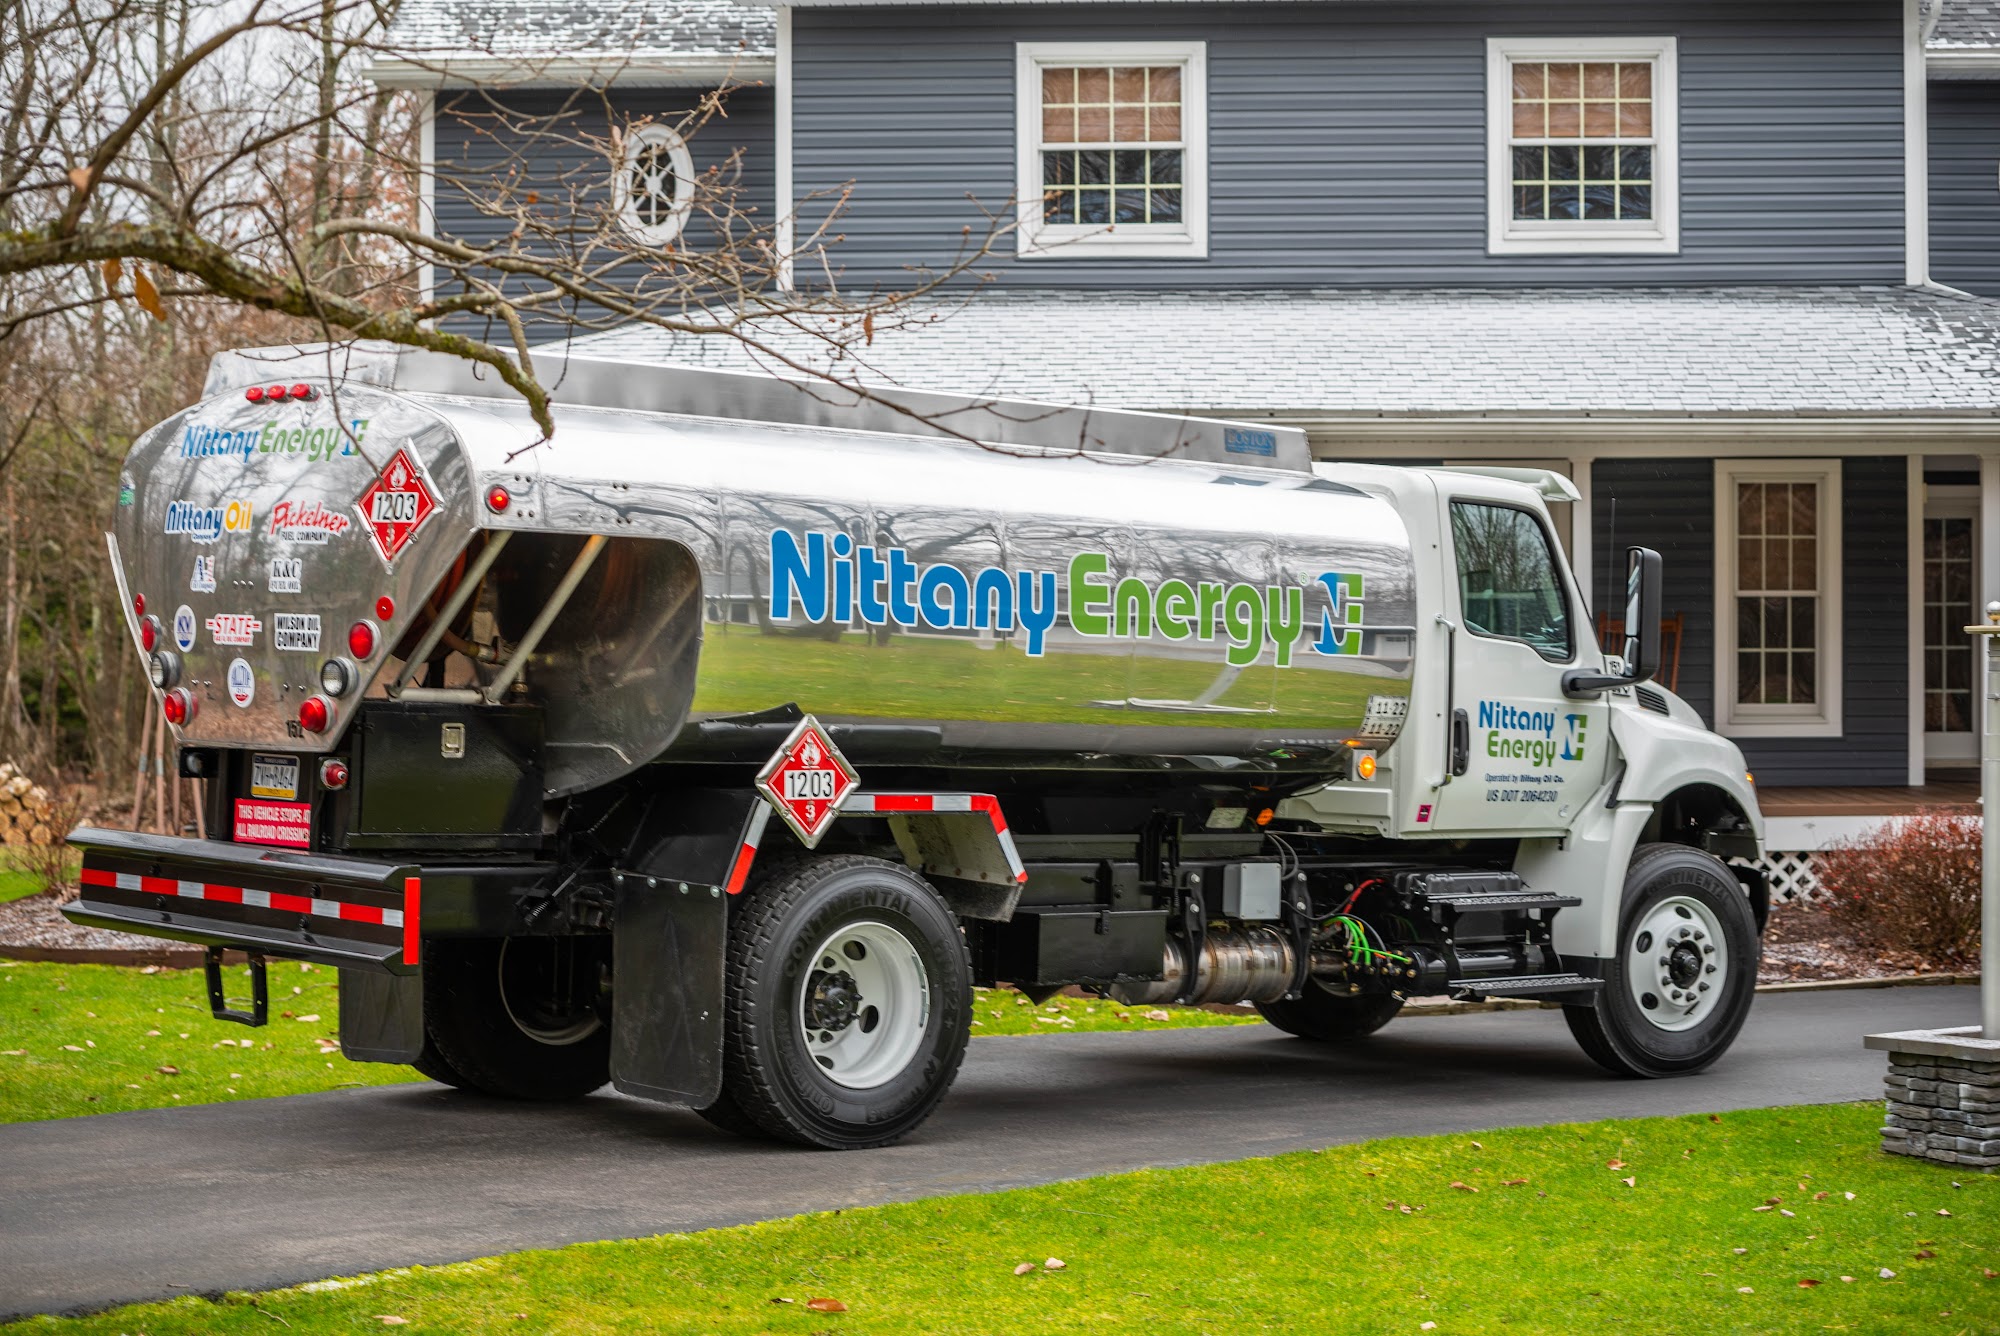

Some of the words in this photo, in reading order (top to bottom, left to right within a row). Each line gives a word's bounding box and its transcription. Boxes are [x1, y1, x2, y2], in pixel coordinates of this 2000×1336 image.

[180, 424, 260, 464] Nittany
[259, 420, 342, 463] Energy
[225, 501, 253, 531] Oil
[377, 493, 416, 521] 1203
[269, 500, 349, 535] Pickelner
[769, 528, 1057, 657] Nittany
[1068, 552, 1303, 668] Energy
[214, 616, 252, 635] STATE
[277, 616, 304, 630] WILSON
[307, 617, 319, 631] OIL
[277, 631, 318, 649] COMPANY
[1375, 702, 1407, 716] 11-22
[1368, 722, 1401, 736] 11-22
[1479, 700, 1555, 739] Nittany
[1487, 730, 1557, 768] Energy
[789, 771, 833, 798] 1203
[1520, 774, 1541, 785] Nittany
[1543, 774, 1552, 783] Oil
[1553, 775, 1565, 783] Co.
[1486, 789, 1500, 802] US
[1500, 789, 1520, 802] DOT
[238, 804, 253, 819] THIS
[253, 805, 280, 821] VEHICLE
[280, 807, 303, 824] STOPS
[804, 804, 816, 819] 3
[236, 822, 247, 837] ALL
[247, 823, 276, 840] RAILROAD
[784, 887, 914, 978] CONTINENTAL
